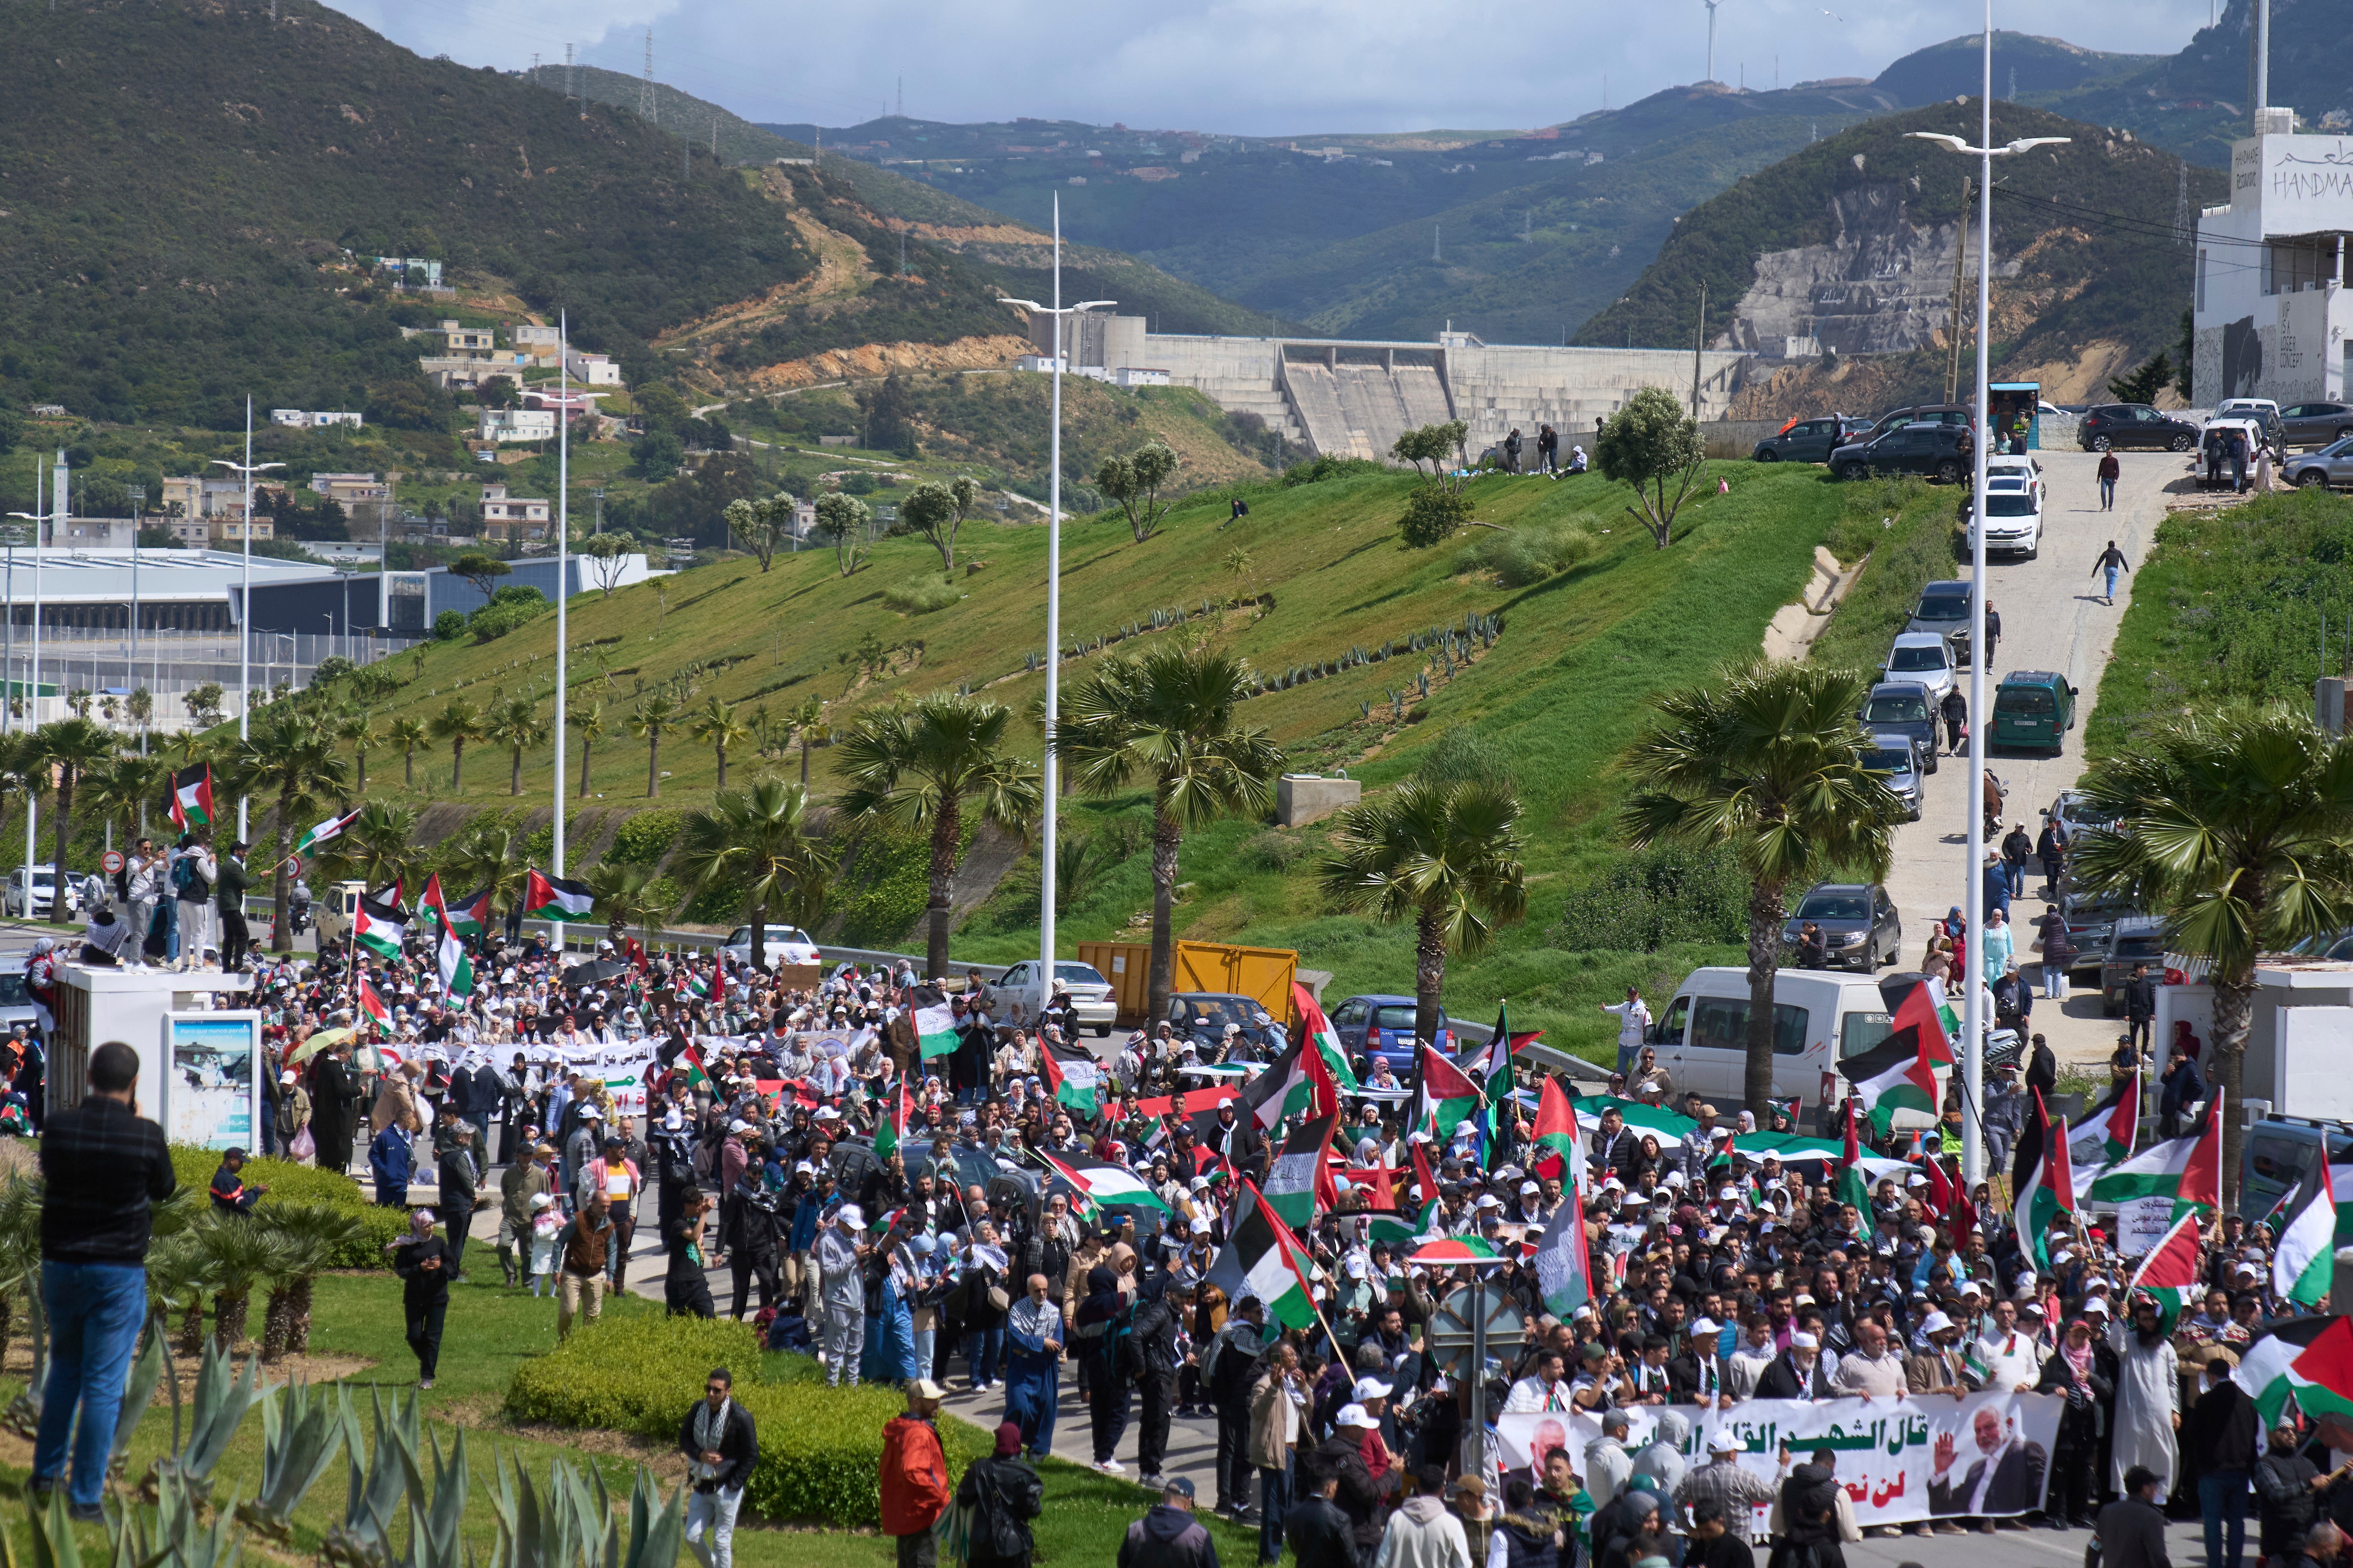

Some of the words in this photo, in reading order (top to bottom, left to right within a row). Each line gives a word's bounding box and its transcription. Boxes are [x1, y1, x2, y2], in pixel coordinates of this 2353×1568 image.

[2235, 147, 2259, 168] HANDMADE
[2273, 140, 2353, 167] طعم
[2282, 301, 2290, 318] VIP
[2281, 319, 2286, 334] IS
[2287, 319, 2290, 335] A
[2281, 336, 2296, 351] LOSER
[2280, 352, 2303, 368] CONCEPT
[604, 1054, 617, 1068] مع
[2153, 1213, 2171, 1224] خدام
[1784, 1418, 1886, 1452] الشهيد
[1888, 1413, 1928, 1456] قال
[1872, 1470, 1905, 1508] لن
